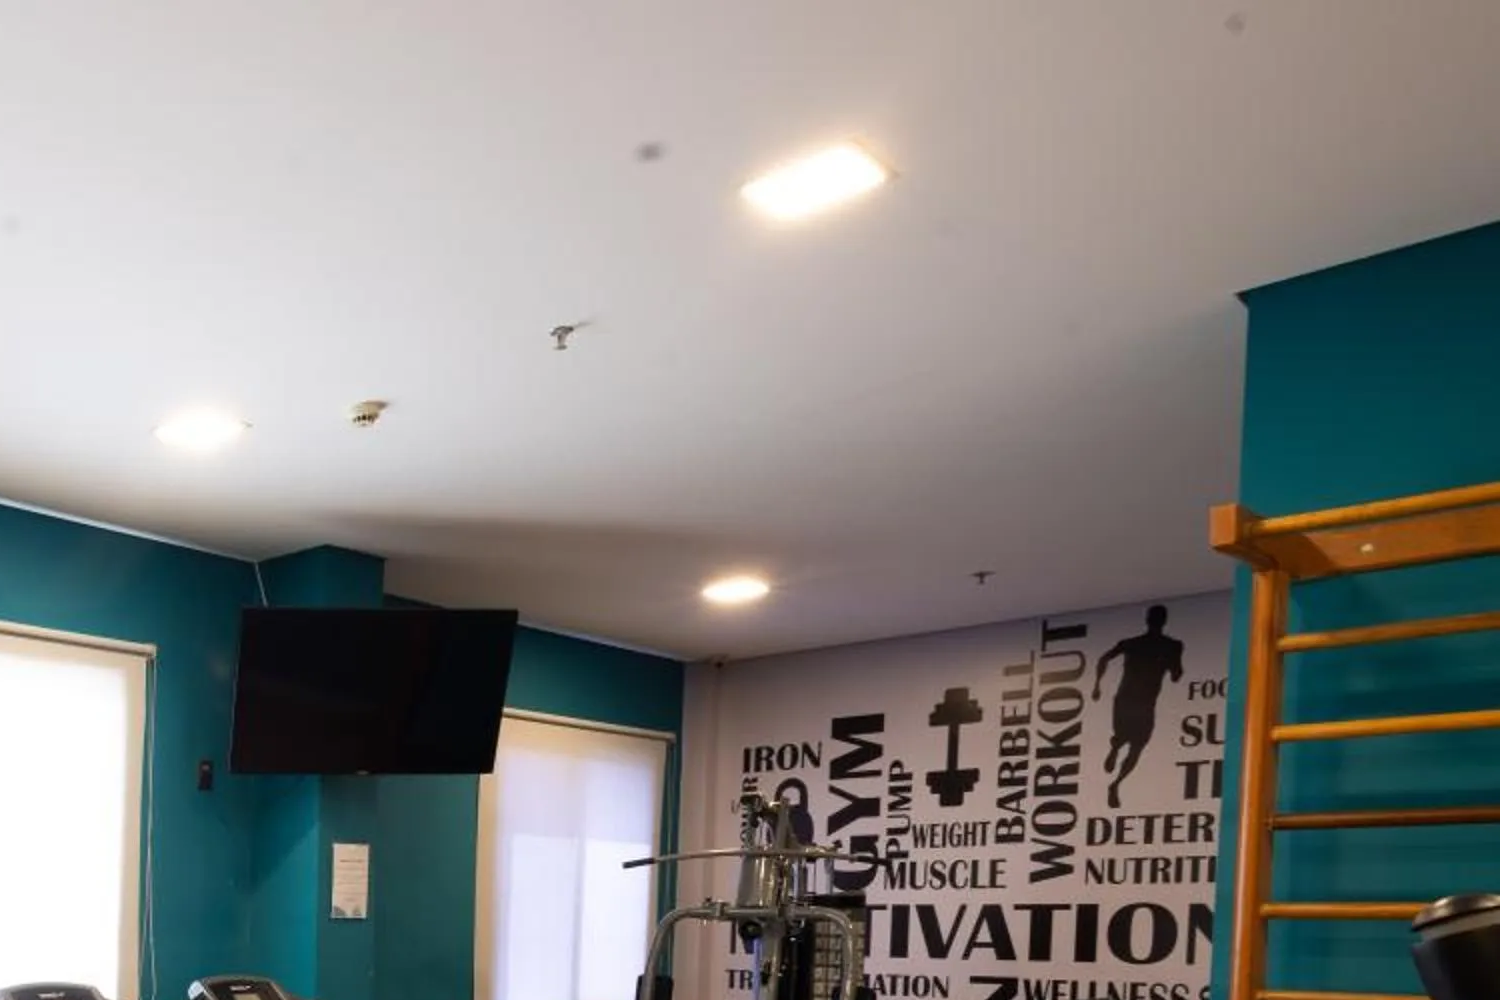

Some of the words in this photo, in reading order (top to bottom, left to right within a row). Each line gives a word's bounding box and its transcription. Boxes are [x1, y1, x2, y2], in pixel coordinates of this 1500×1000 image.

[742, 741, 822, 773] IRON
[995, 650, 1035, 844] BARBELL
[1029, 620, 1087, 884] WORKOUT
[827, 713, 885, 890] GYM
[886, 760, 913, 858] PUMP
[912, 821, 990, 848] WEIGHT
[883, 858, 1007, 890] MUSCLE
